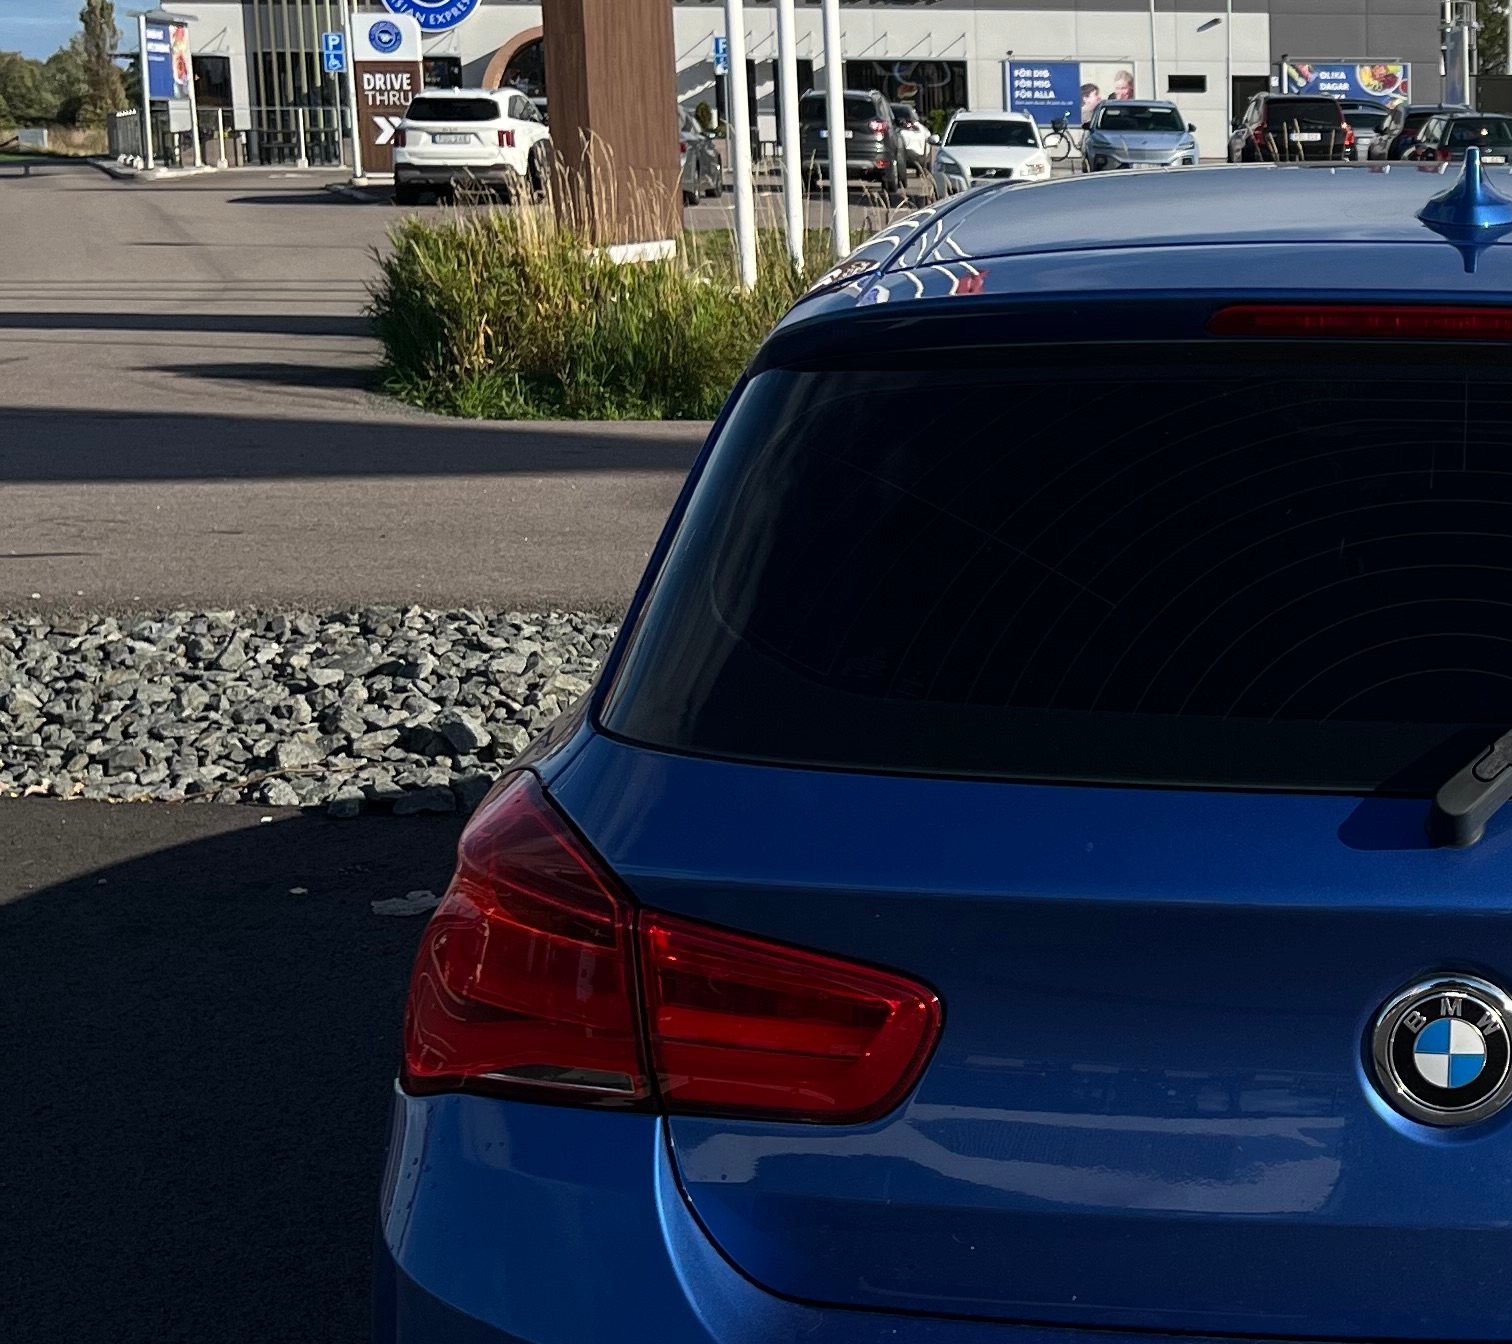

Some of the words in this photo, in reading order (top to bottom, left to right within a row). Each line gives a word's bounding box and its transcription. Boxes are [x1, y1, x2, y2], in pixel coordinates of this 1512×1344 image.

[328, 35, 340, 51] P
[1013, 68, 1032, 78] FÖR
[363, 72, 412, 90] DRIVE
[1014, 79, 1032, 88] FÖR
[364, 91, 413, 106] THRU
[1014, 89, 1033, 99] FÖR
[1034, 90, 1056, 99] ALLA
[1403, 997, 1501, 1037] BMW
